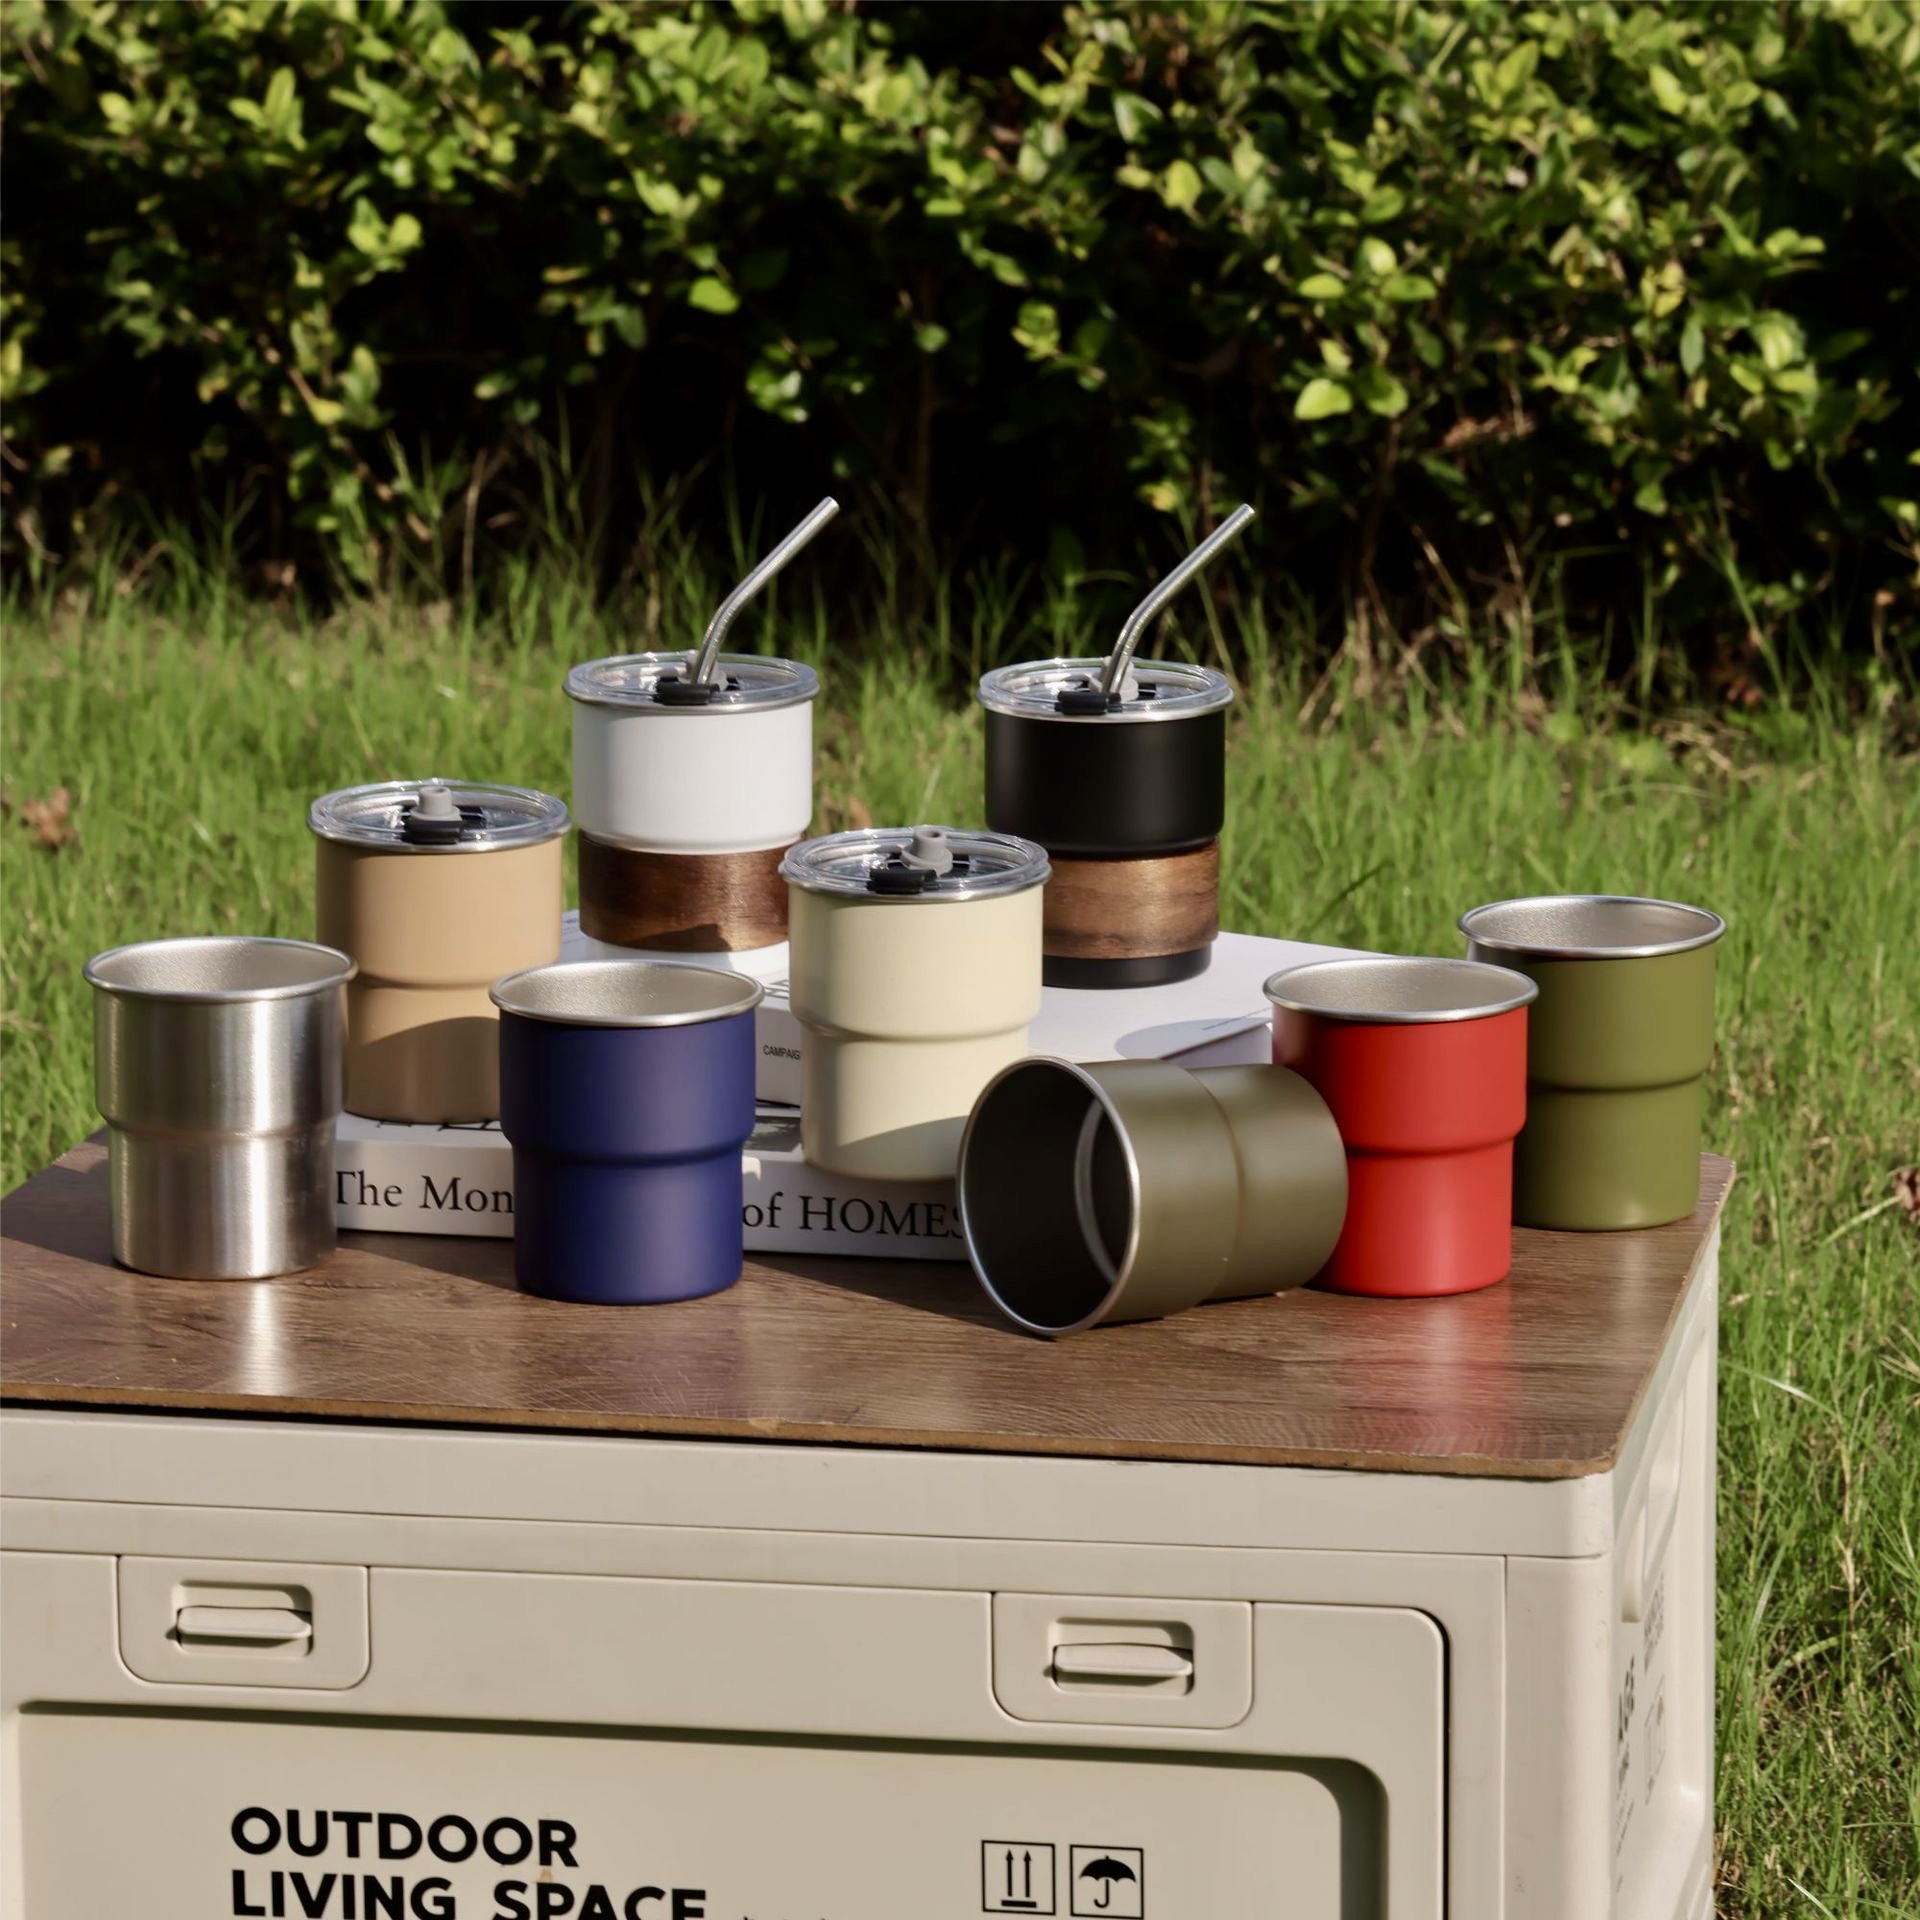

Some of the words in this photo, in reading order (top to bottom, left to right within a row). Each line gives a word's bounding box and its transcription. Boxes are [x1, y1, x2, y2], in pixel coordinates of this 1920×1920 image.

[336, 1170, 402, 1207] The
[419, 1175, 514, 1213] Mon
[742, 1191, 783, 1228] of
[231, 1807, 579, 1867] OUTDOOR
[232, 1869, 455, 1920] LIVING
[492, 1880, 706, 1920] SPACE
